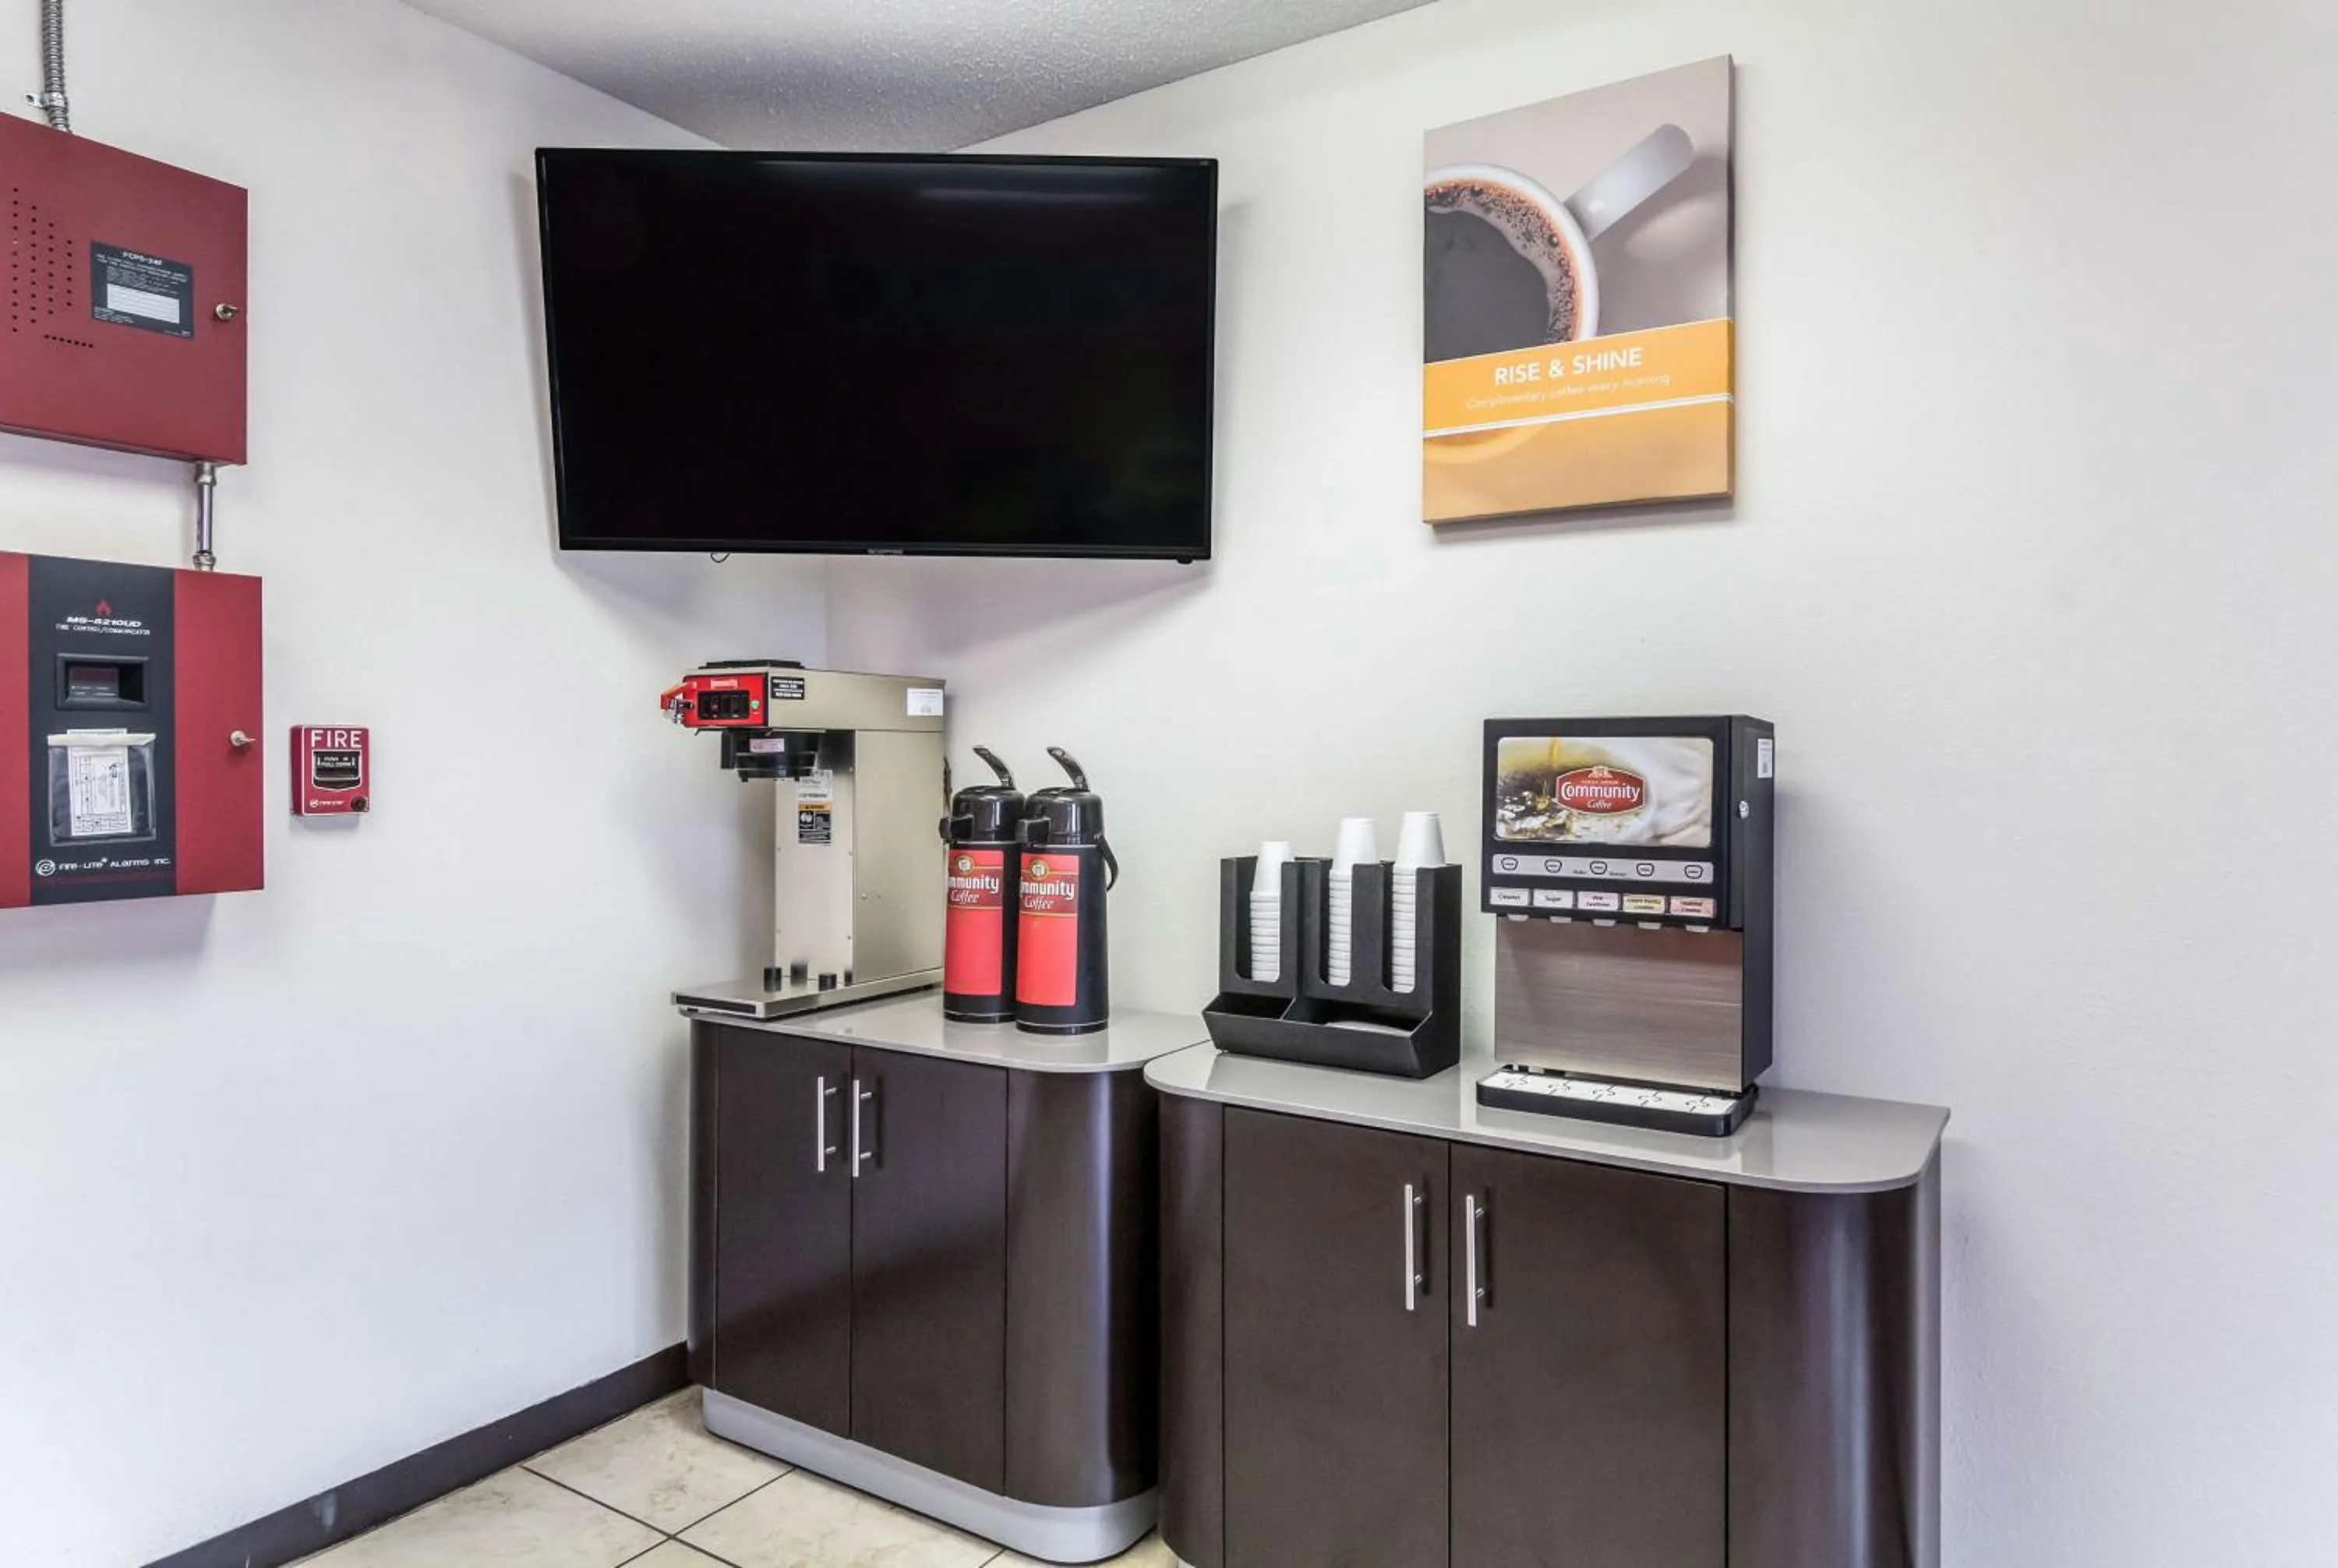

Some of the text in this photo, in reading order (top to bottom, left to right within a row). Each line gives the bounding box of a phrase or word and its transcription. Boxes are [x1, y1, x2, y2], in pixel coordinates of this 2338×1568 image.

[1495, 347, 1644, 386] RISE & SHINE
[1465, 373, 1671, 411] Complimentary coffee every morning
[311, 729, 362, 748] FIRE
[1561, 782, 1640, 801] Community
[1587, 799, 1612, 809] Coffee
[948, 874, 999, 894] mmunity
[1022, 880, 1074, 900] mmunity
[951, 889, 980, 905] Coffee
[1024, 897, 1054, 911] Coffee
